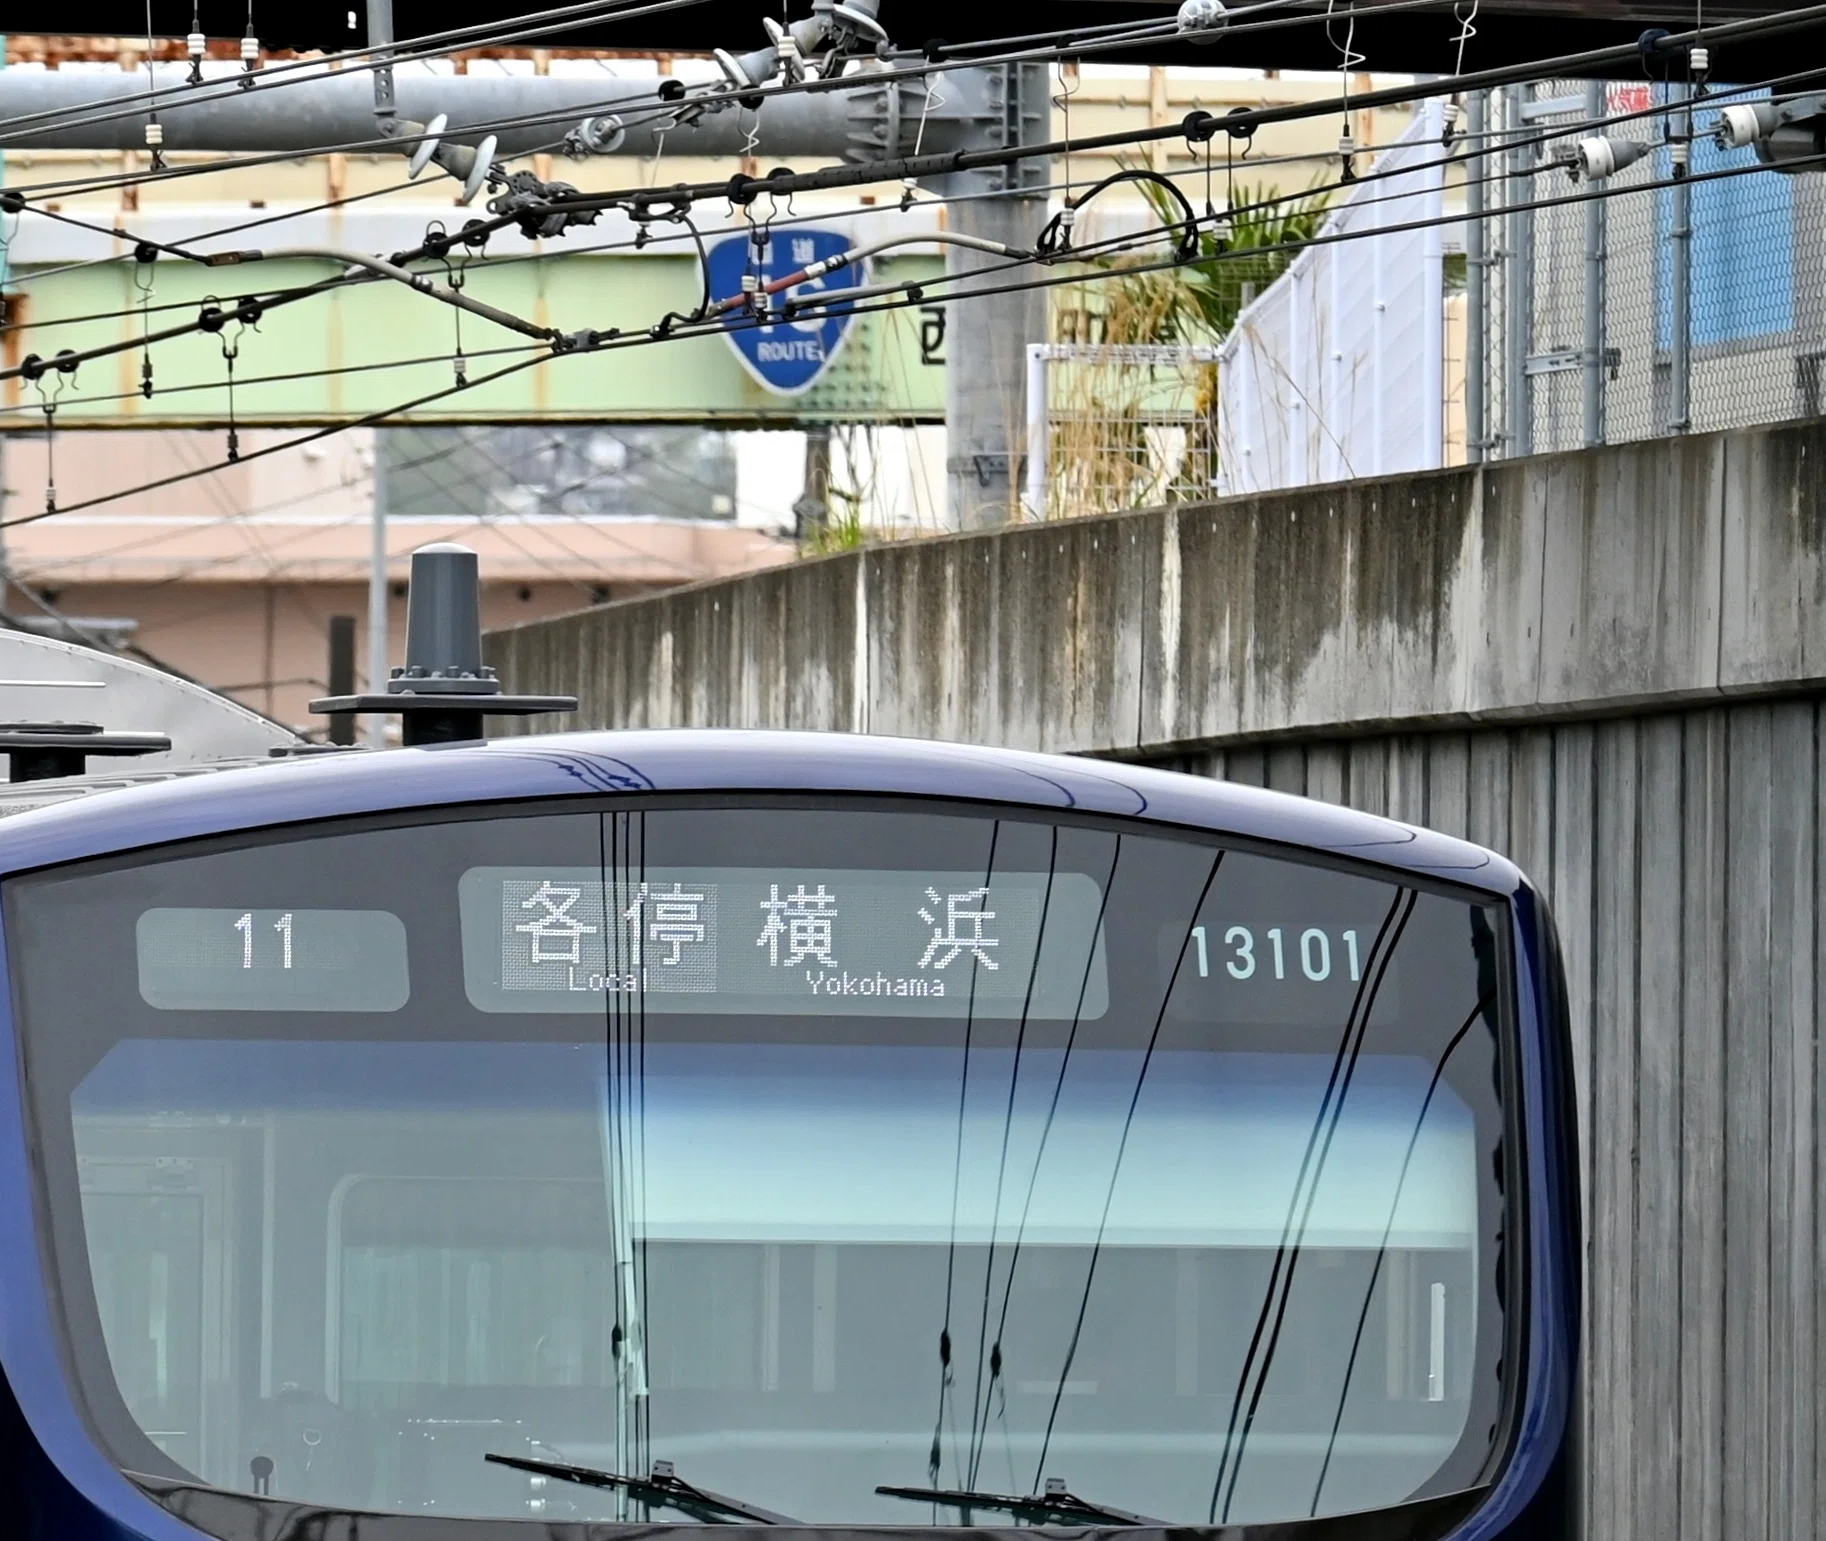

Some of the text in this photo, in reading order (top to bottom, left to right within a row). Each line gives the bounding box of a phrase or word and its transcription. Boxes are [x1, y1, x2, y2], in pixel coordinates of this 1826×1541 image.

[757, 340, 820, 362] ROUTE
[234, 913, 293, 969] 11
[514, 880, 999, 971] 各停 横浜
[1191, 925, 1360, 982] 13101
[569, 966, 647, 992] Local
[806, 970, 945, 997] Yokohama
